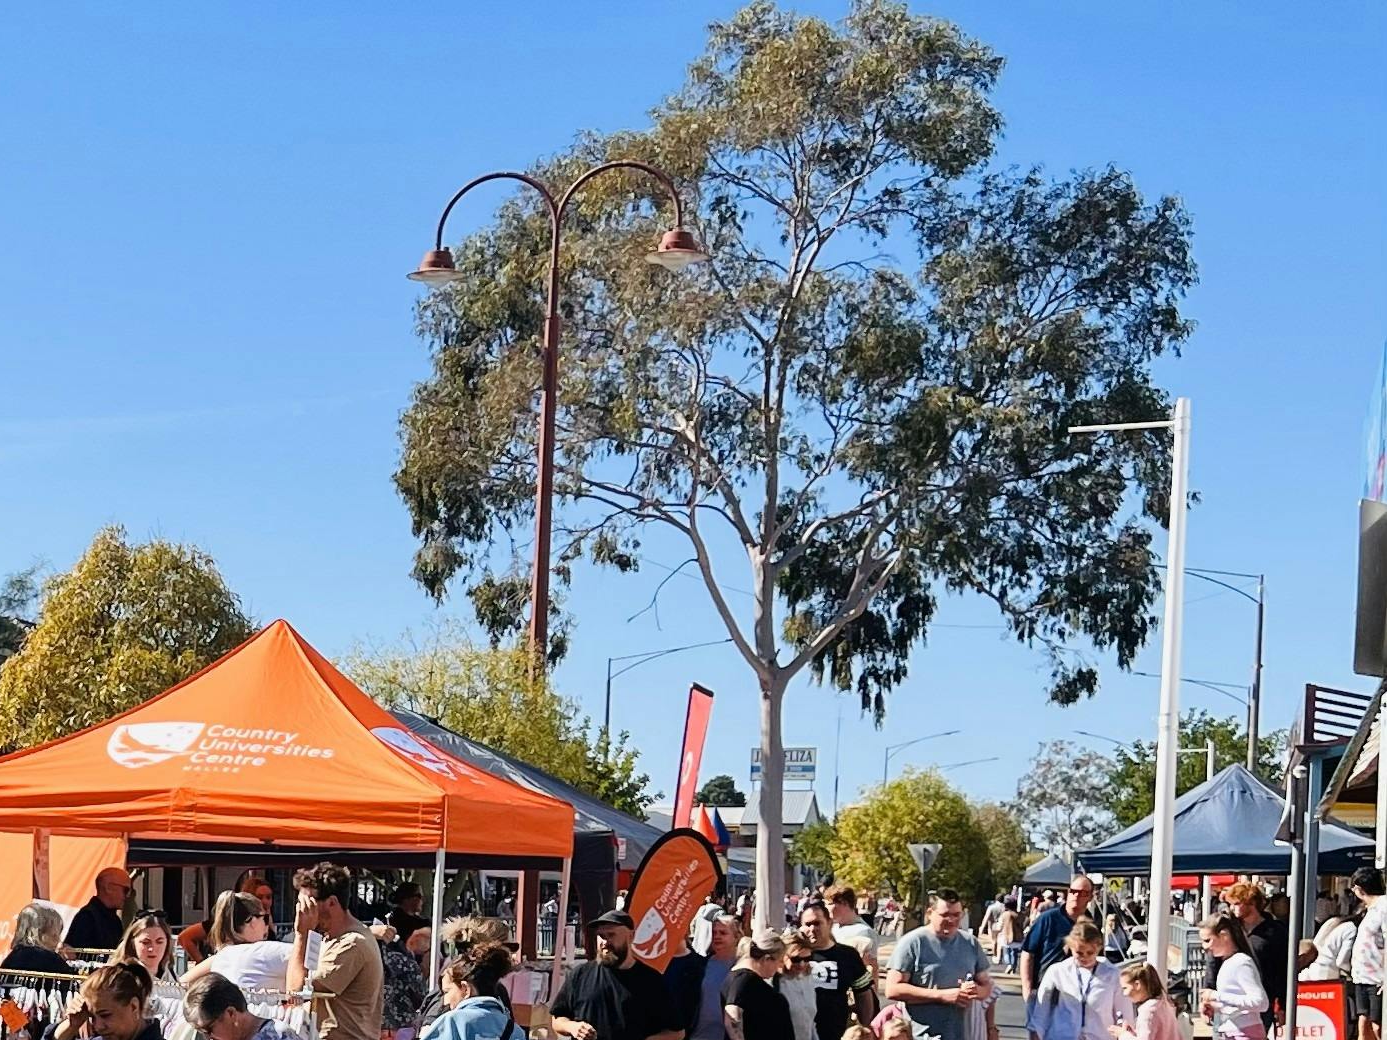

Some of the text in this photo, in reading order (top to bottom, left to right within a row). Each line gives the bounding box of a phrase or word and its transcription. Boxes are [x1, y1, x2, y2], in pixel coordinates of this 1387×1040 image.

[207, 725, 300, 743] Country
[199, 738, 335, 759] Universities
[190, 751, 266, 767] Centre
[654, 868, 682, 910] Country
[1276, 1026, 1325, 1038] OTLET
